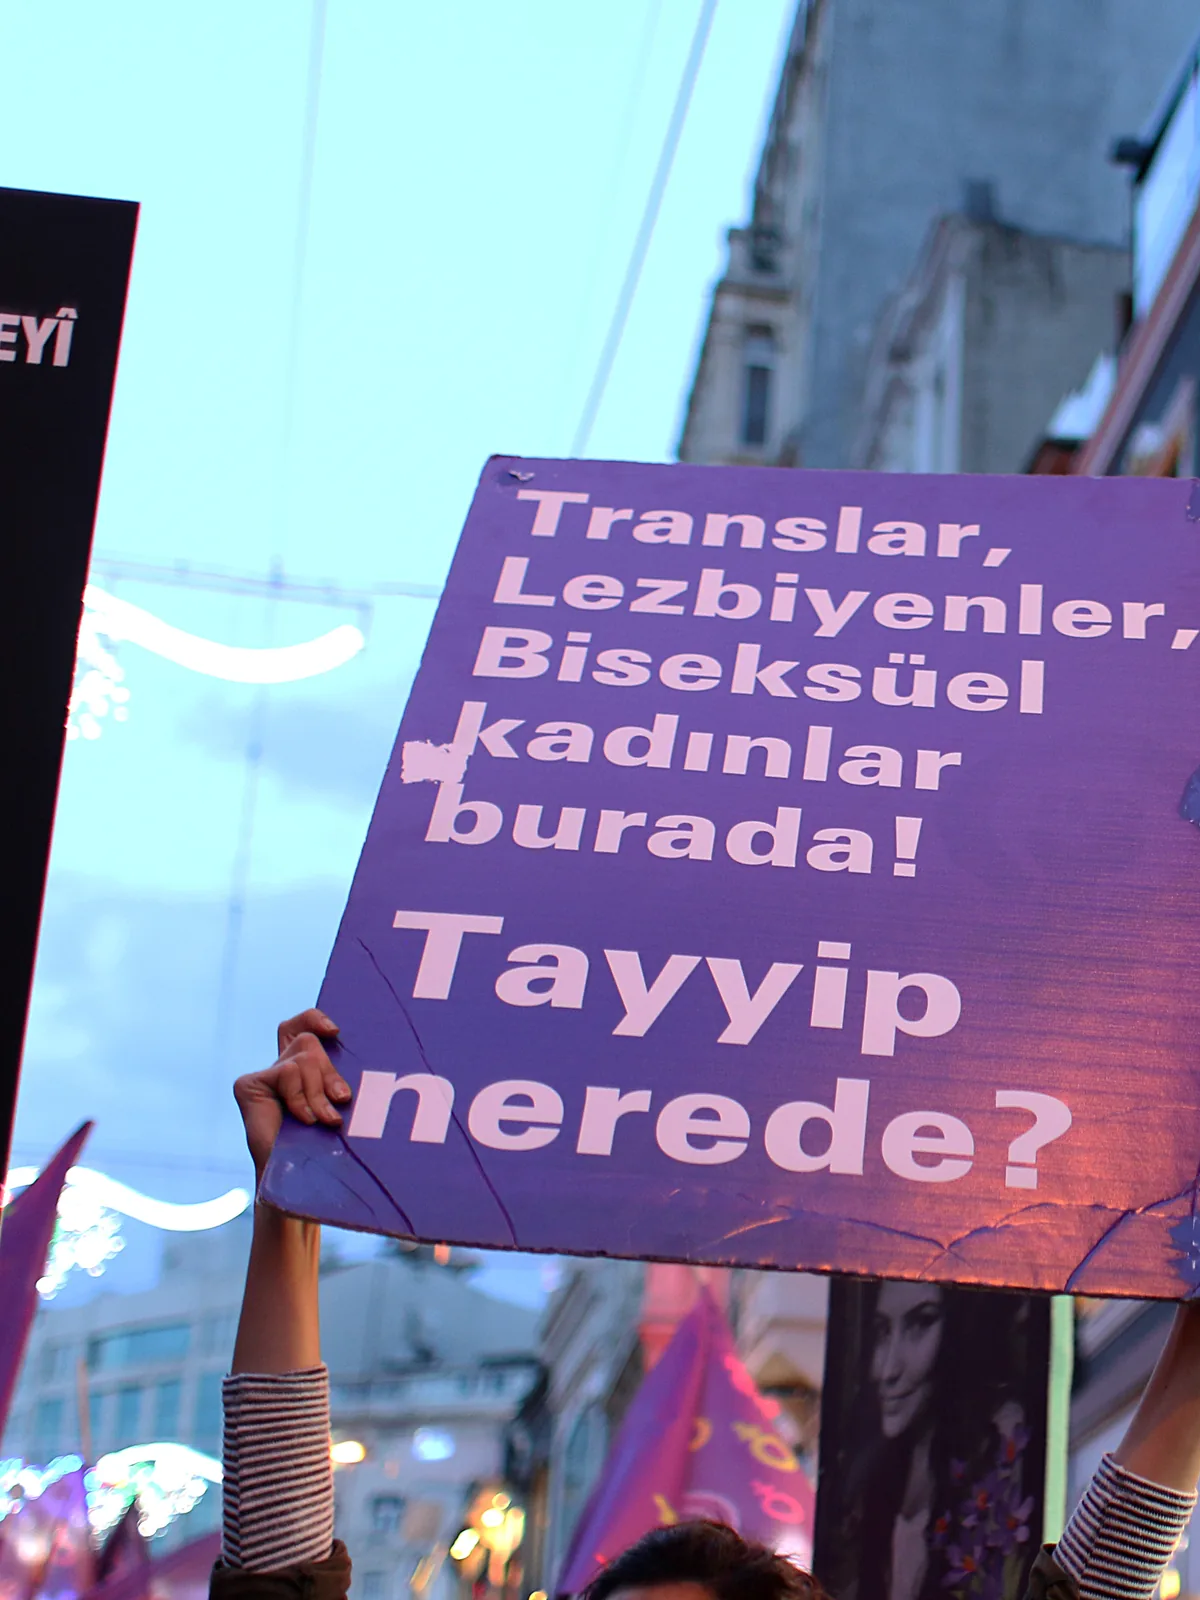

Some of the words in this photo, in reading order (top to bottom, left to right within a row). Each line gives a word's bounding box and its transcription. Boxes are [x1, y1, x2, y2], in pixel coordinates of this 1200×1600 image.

[516, 489, 1012, 568] Translar,
[493, 556, 1200, 650] Lezbiyenler,
[472, 626, 1045, 715] Biseksüel
[453, 700, 962, 791] kadınlar
[424, 783, 923, 878] burada!
[392, 910, 962, 1057] Tayyip
[347, 1070, 1073, 1190] nerede?
